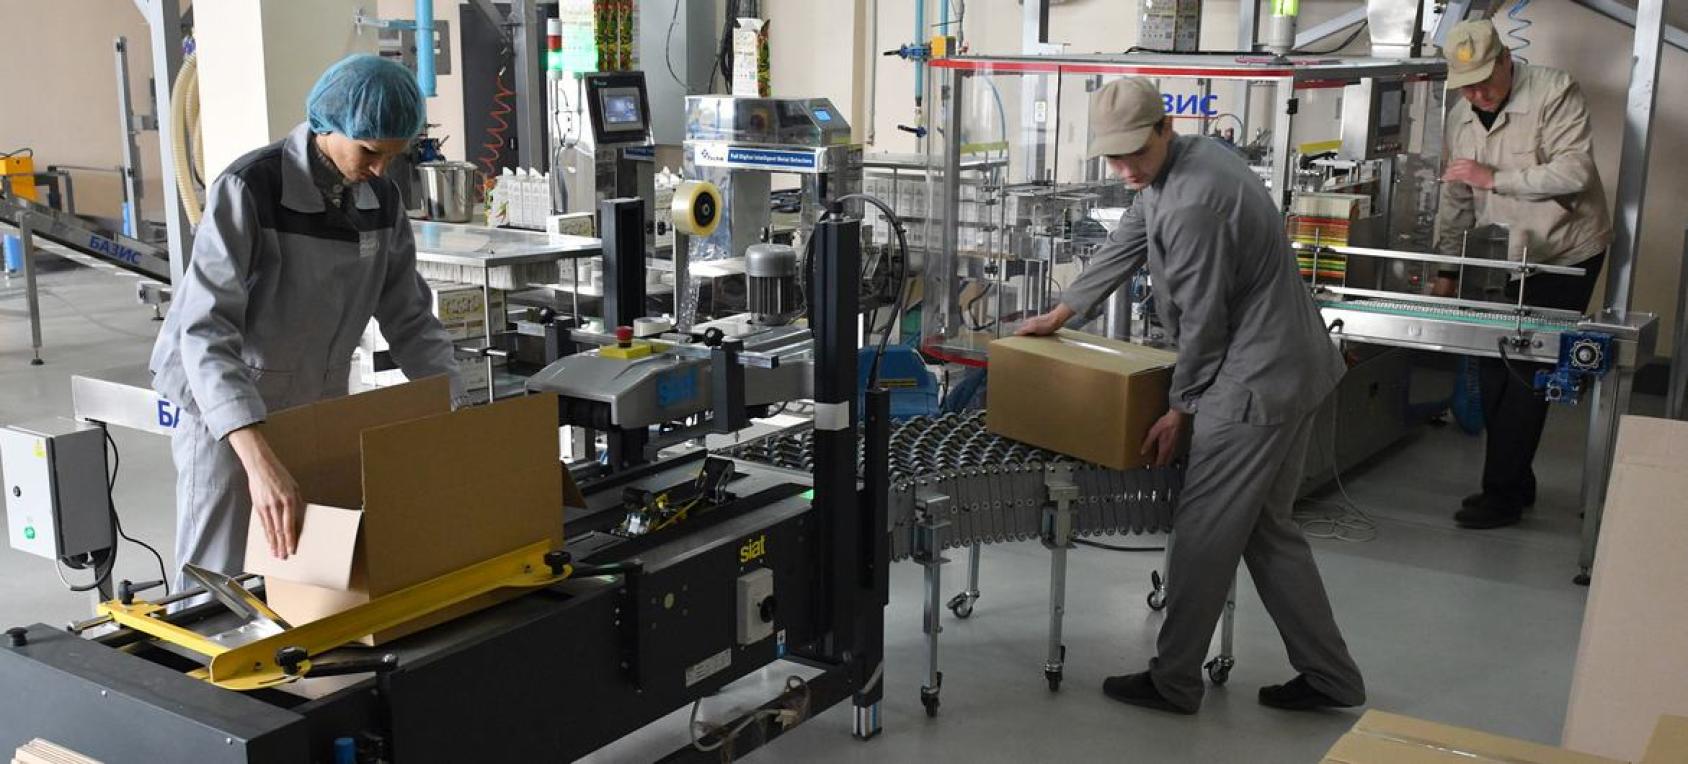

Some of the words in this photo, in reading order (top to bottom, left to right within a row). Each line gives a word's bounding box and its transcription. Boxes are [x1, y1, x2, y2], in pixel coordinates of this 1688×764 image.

[90, 236, 142, 264] БАЗИС
[659, 371, 696, 405] siat
[740, 535, 767, 562] siat
